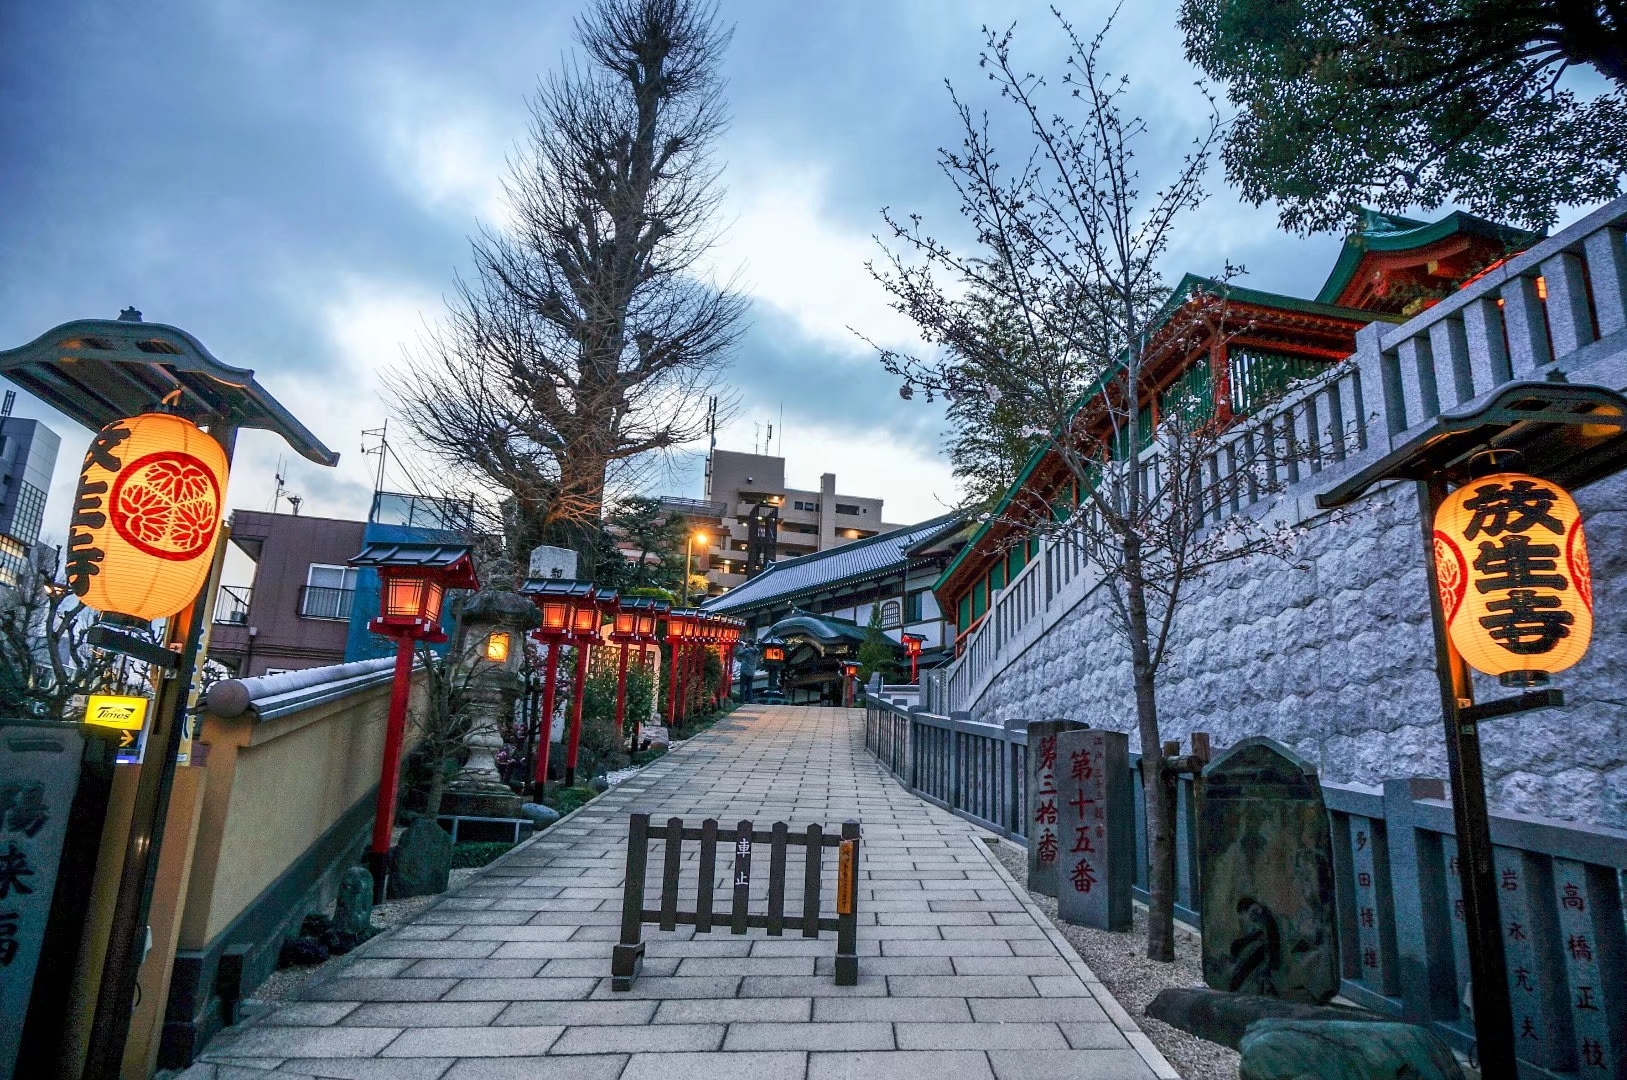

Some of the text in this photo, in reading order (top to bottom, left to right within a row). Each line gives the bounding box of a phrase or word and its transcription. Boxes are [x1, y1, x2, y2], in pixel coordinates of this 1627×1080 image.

[1463, 480, 1575, 655] 放生寺
[97, 706, 135, 720] Times
[735, 837, 752, 886] 車止
[1069, 748, 1098, 894] 第十五番
[1562, 881, 1608, 1071] 高橋正枝
